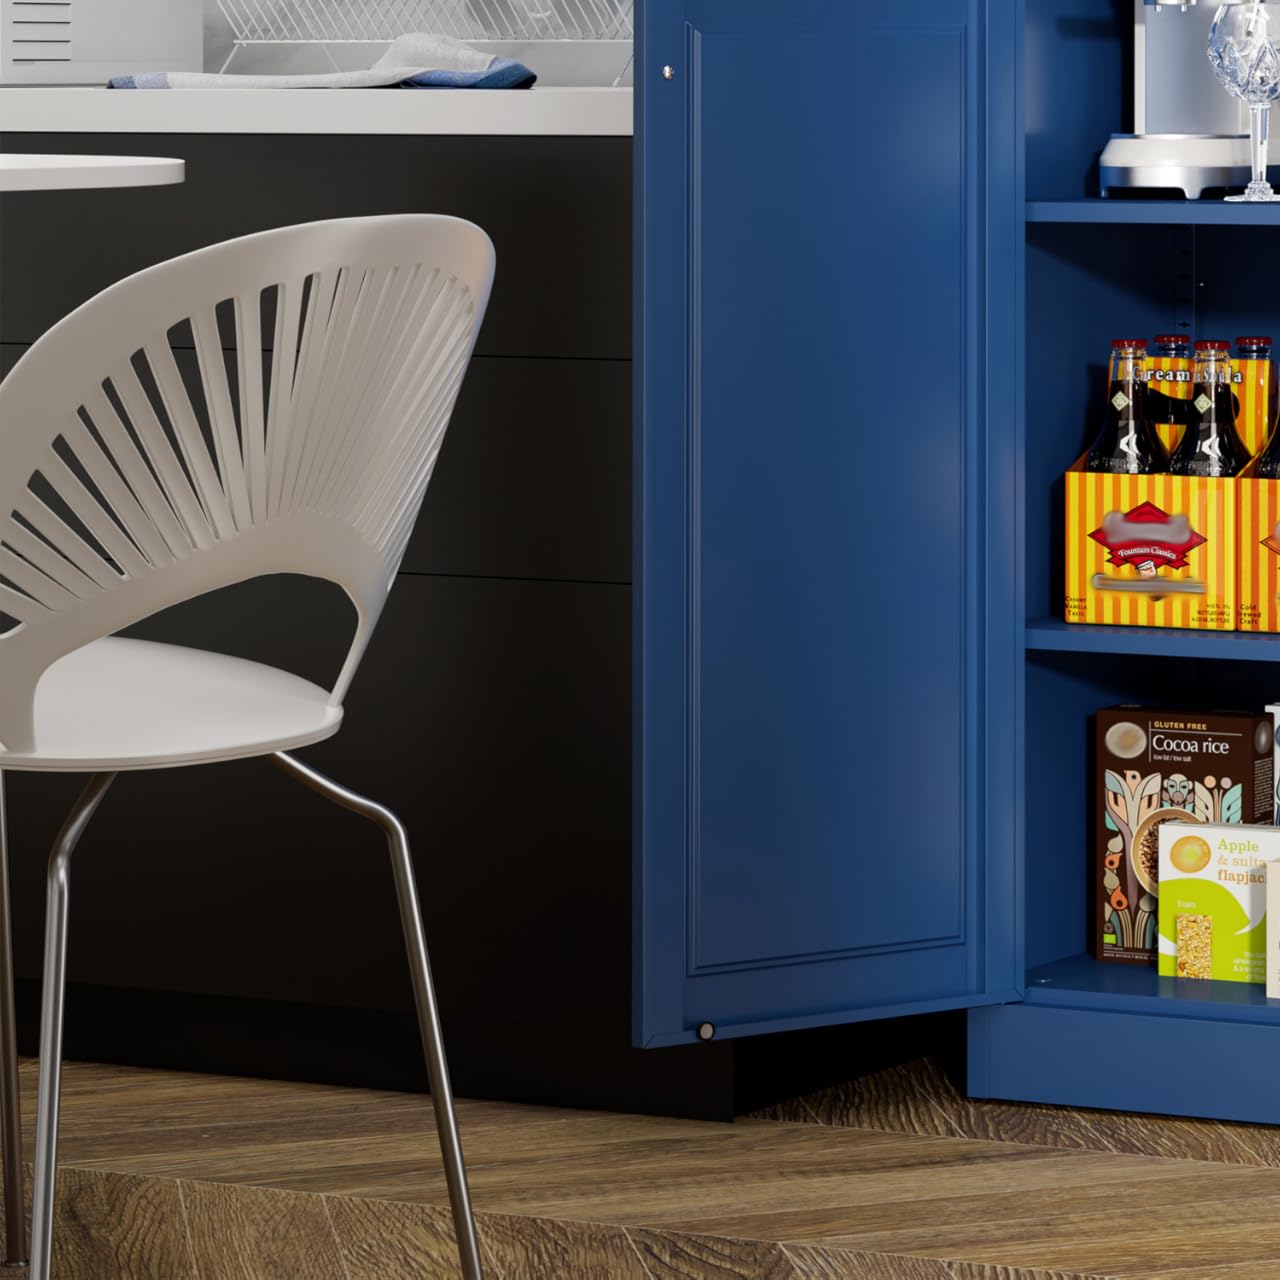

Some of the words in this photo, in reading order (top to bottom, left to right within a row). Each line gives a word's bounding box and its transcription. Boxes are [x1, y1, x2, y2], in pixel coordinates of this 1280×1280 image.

[1118, 547, 1150, 558] Fountain
[1153, 735, 1199, 752] Cocoa
[1203, 738, 1230, 754] rice
[1217, 838, 1259, 853] Apple
[1217, 856, 1228, 865] &
